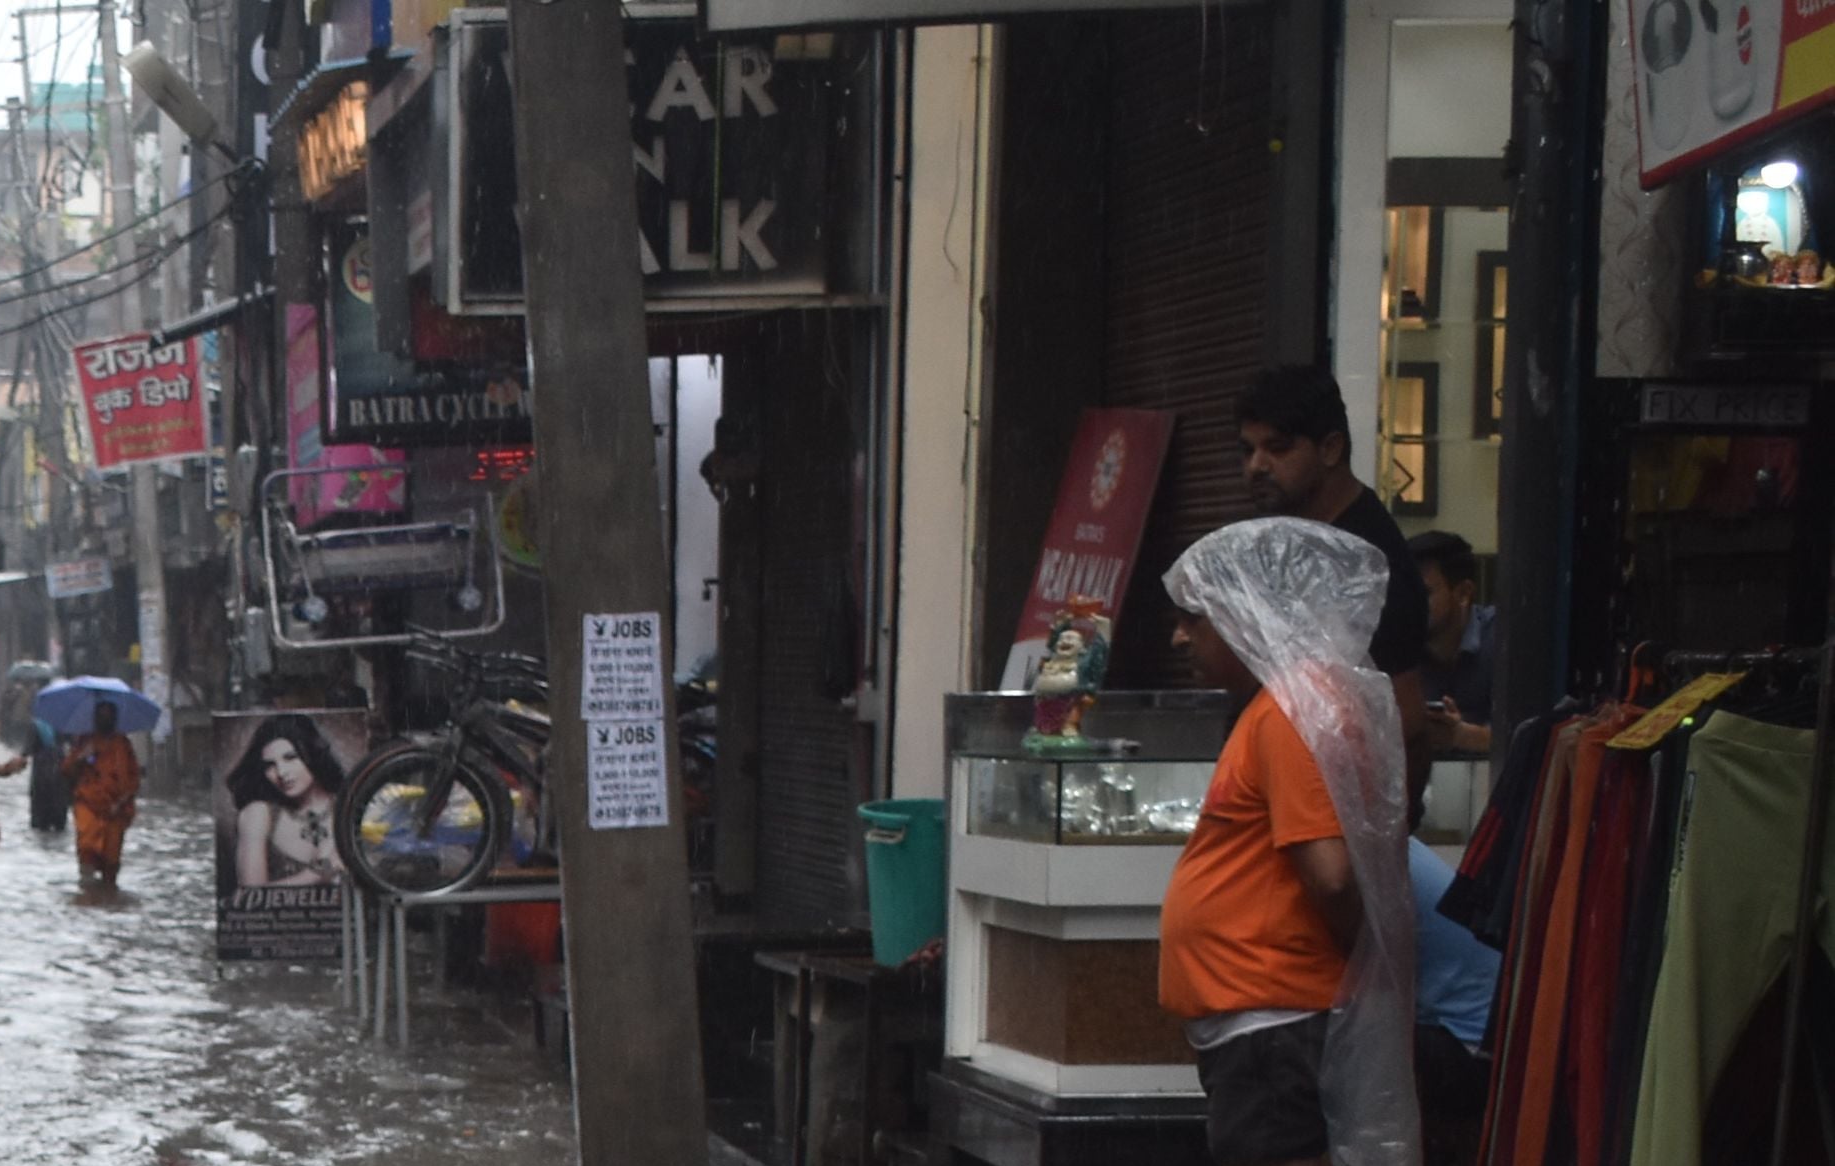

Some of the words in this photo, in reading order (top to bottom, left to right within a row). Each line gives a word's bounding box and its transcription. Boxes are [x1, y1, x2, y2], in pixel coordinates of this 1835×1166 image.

[624, 45, 779, 119] AR
[632, 134, 665, 184] N
[349, 393, 433, 427] BATRA
[1649, 390, 1699, 422] FIX
[1715, 390, 1801, 422] PRICE
[611, 620, 652, 638] JOBS
[615, 727, 655, 745] JOBS
